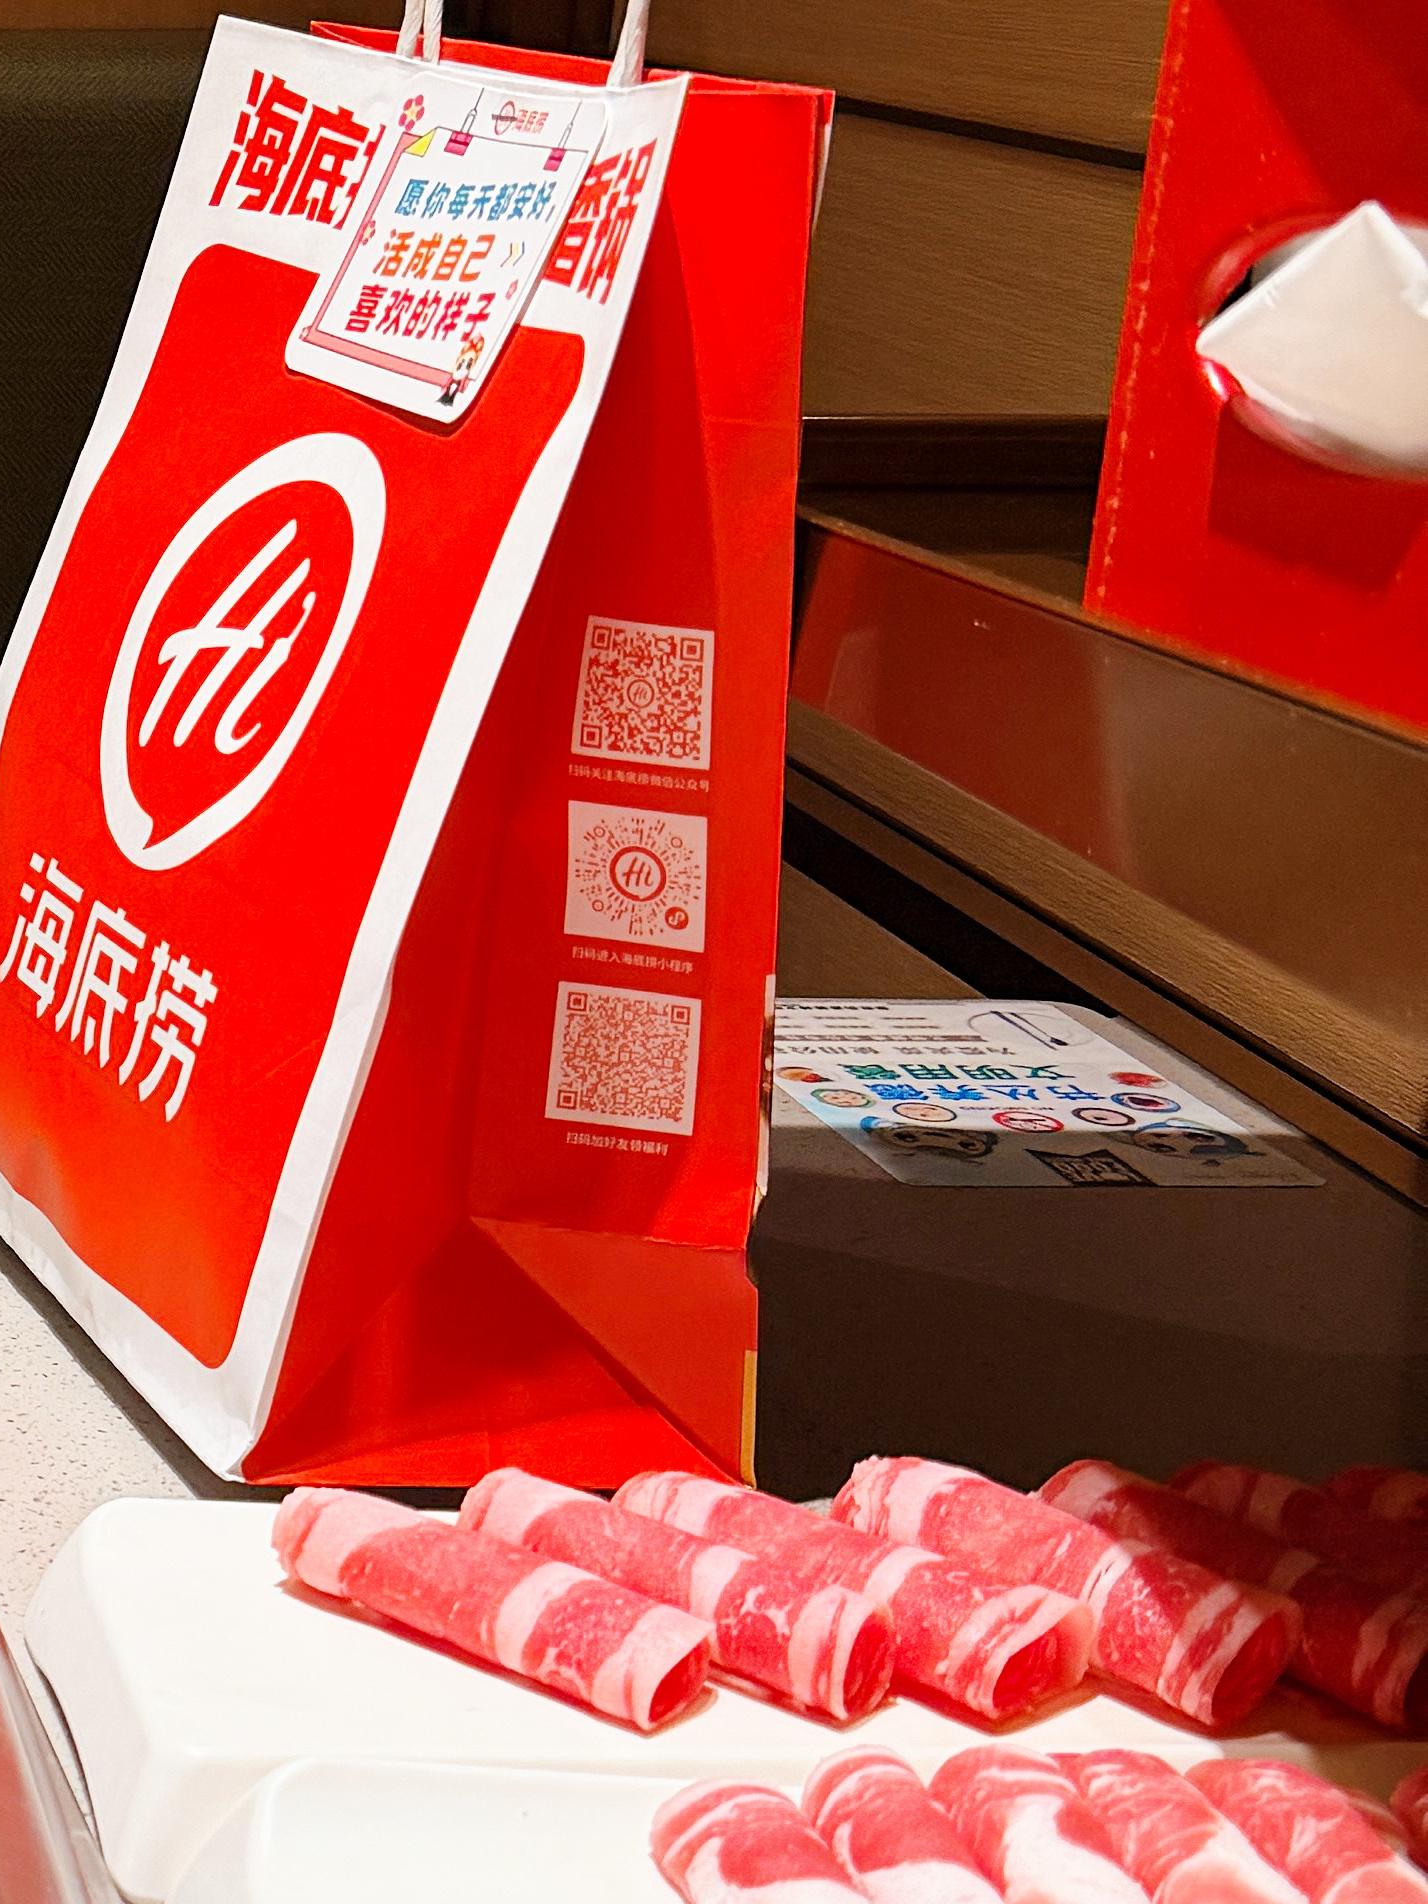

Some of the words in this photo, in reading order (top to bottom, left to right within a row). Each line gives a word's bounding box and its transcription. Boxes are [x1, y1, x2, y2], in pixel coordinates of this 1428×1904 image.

[372, 228, 496, 283] 活成自己
[344, 283, 496, 342] 喜欢的样子
